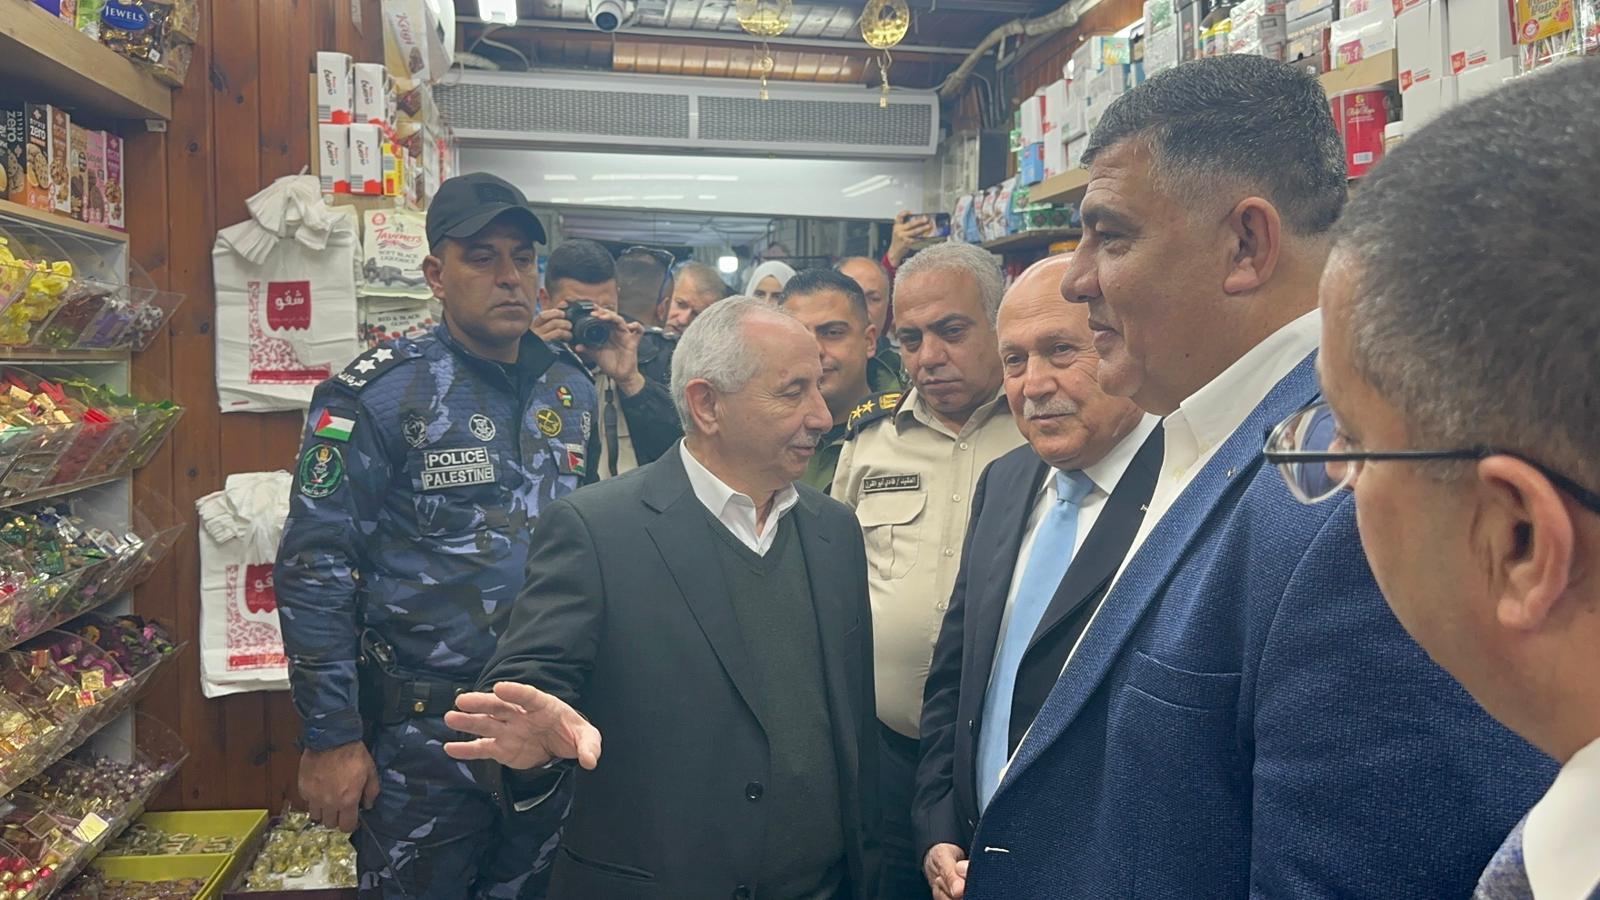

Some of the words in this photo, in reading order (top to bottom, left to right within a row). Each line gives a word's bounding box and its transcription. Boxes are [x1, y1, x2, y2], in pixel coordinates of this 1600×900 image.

[105, 5, 145, 22] JEWELS
[6, 110, 17, 143] zero
[30, 125, 46, 140] zero
[428, 450, 486, 467] POLICE
[425, 467, 492, 486] PALESTINE
